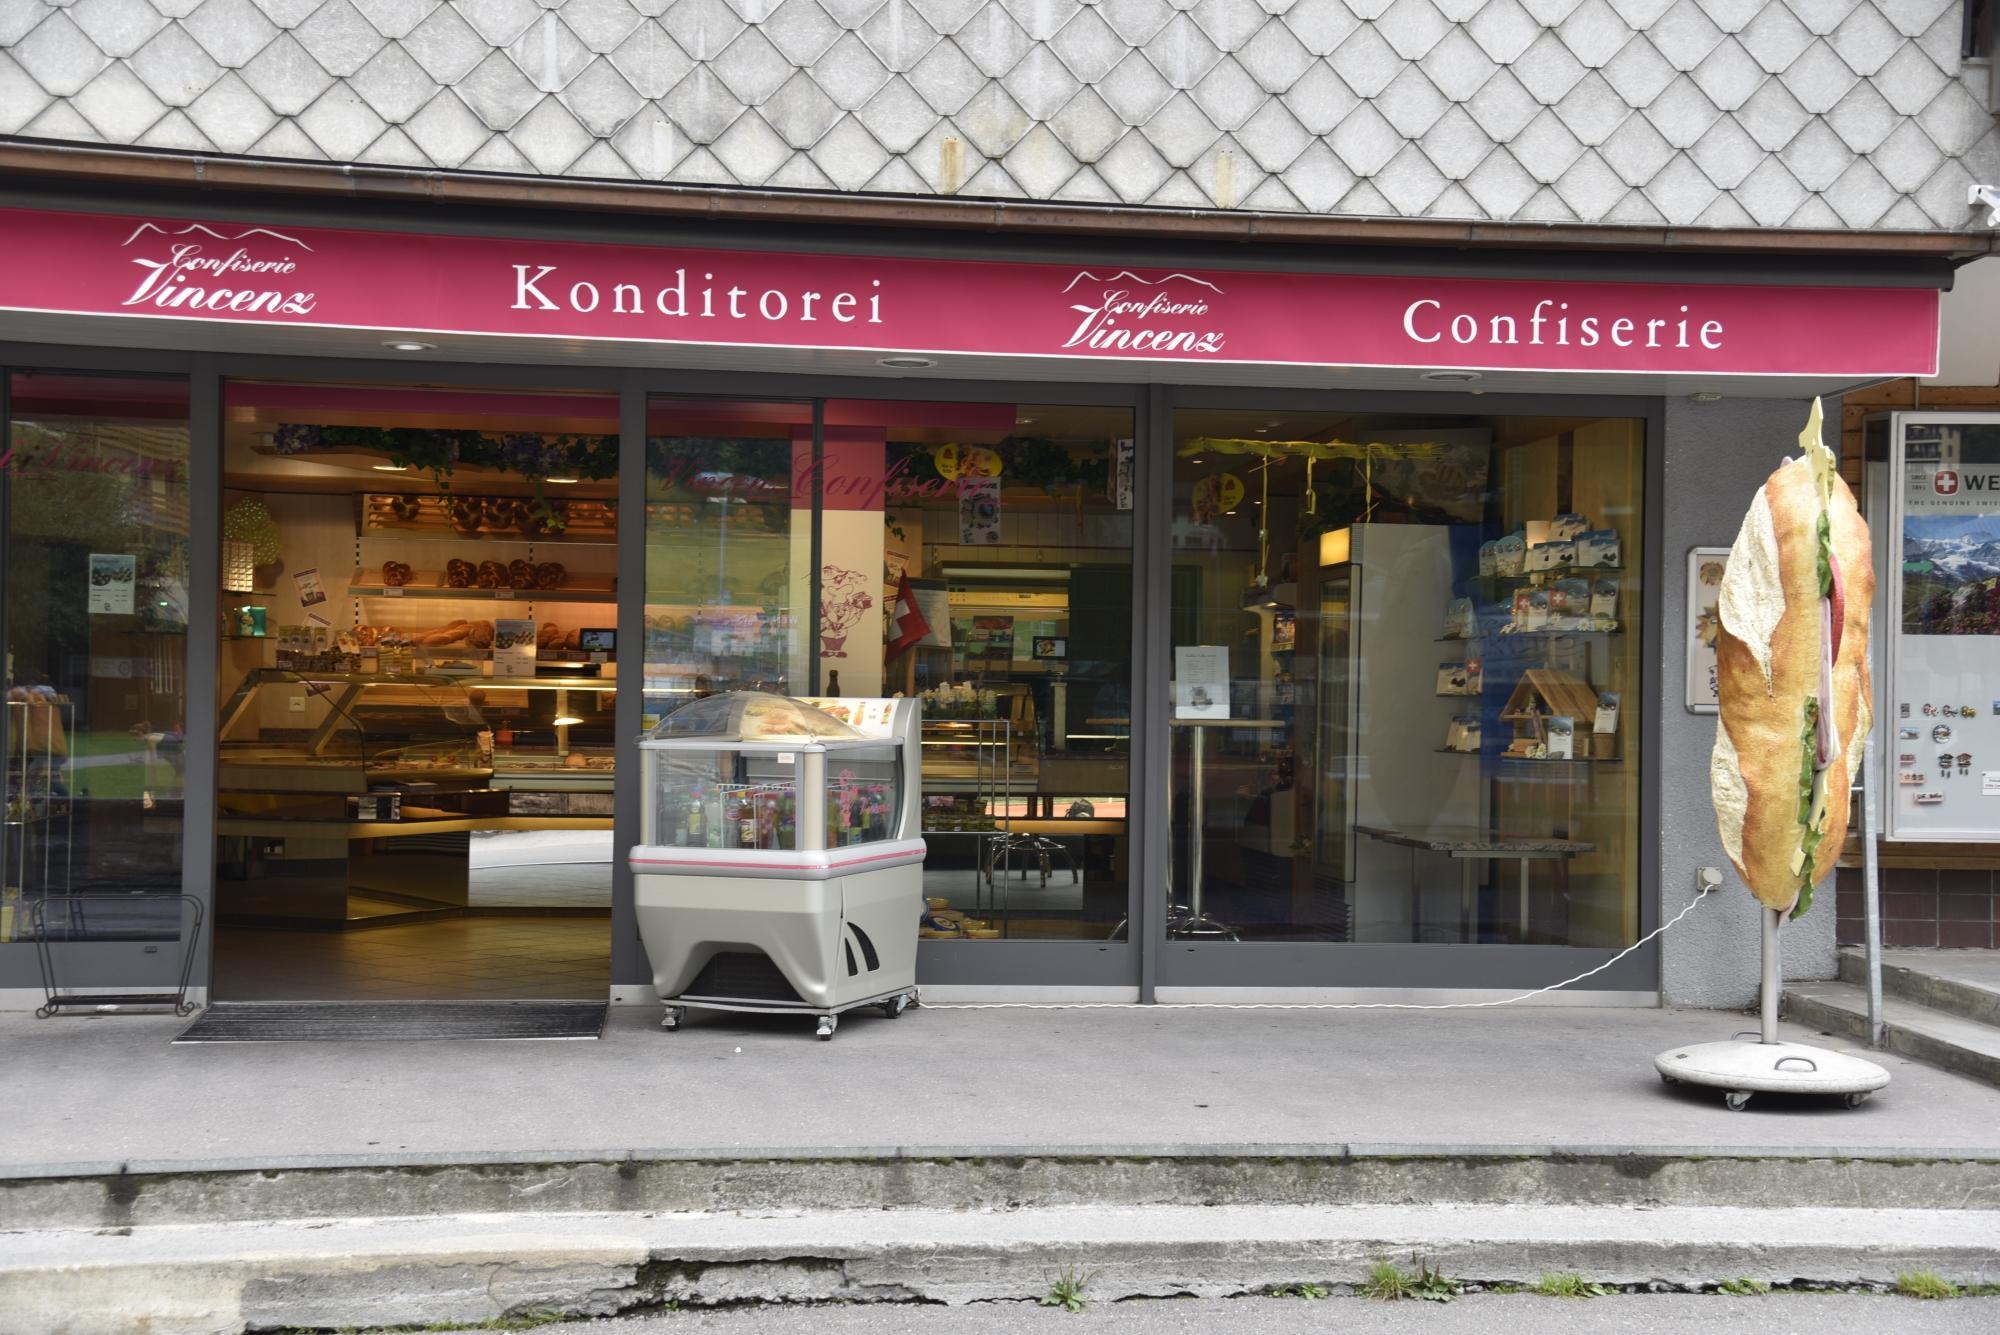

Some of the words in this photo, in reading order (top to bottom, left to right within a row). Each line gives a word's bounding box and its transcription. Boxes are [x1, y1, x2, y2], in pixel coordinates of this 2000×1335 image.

[171, 244, 297, 277] Confiserie
[121, 258, 317, 314] Vincenz
[510, 264, 884, 323] Konditorei
[1103, 290, 1209, 319] Confiserie
[1061, 304, 1226, 353] Vincenz
[1402, 299, 1724, 350] Confiserie
[792, 452, 1000, 510] Confiserie
[1964, 475, 2000, 490] WE
